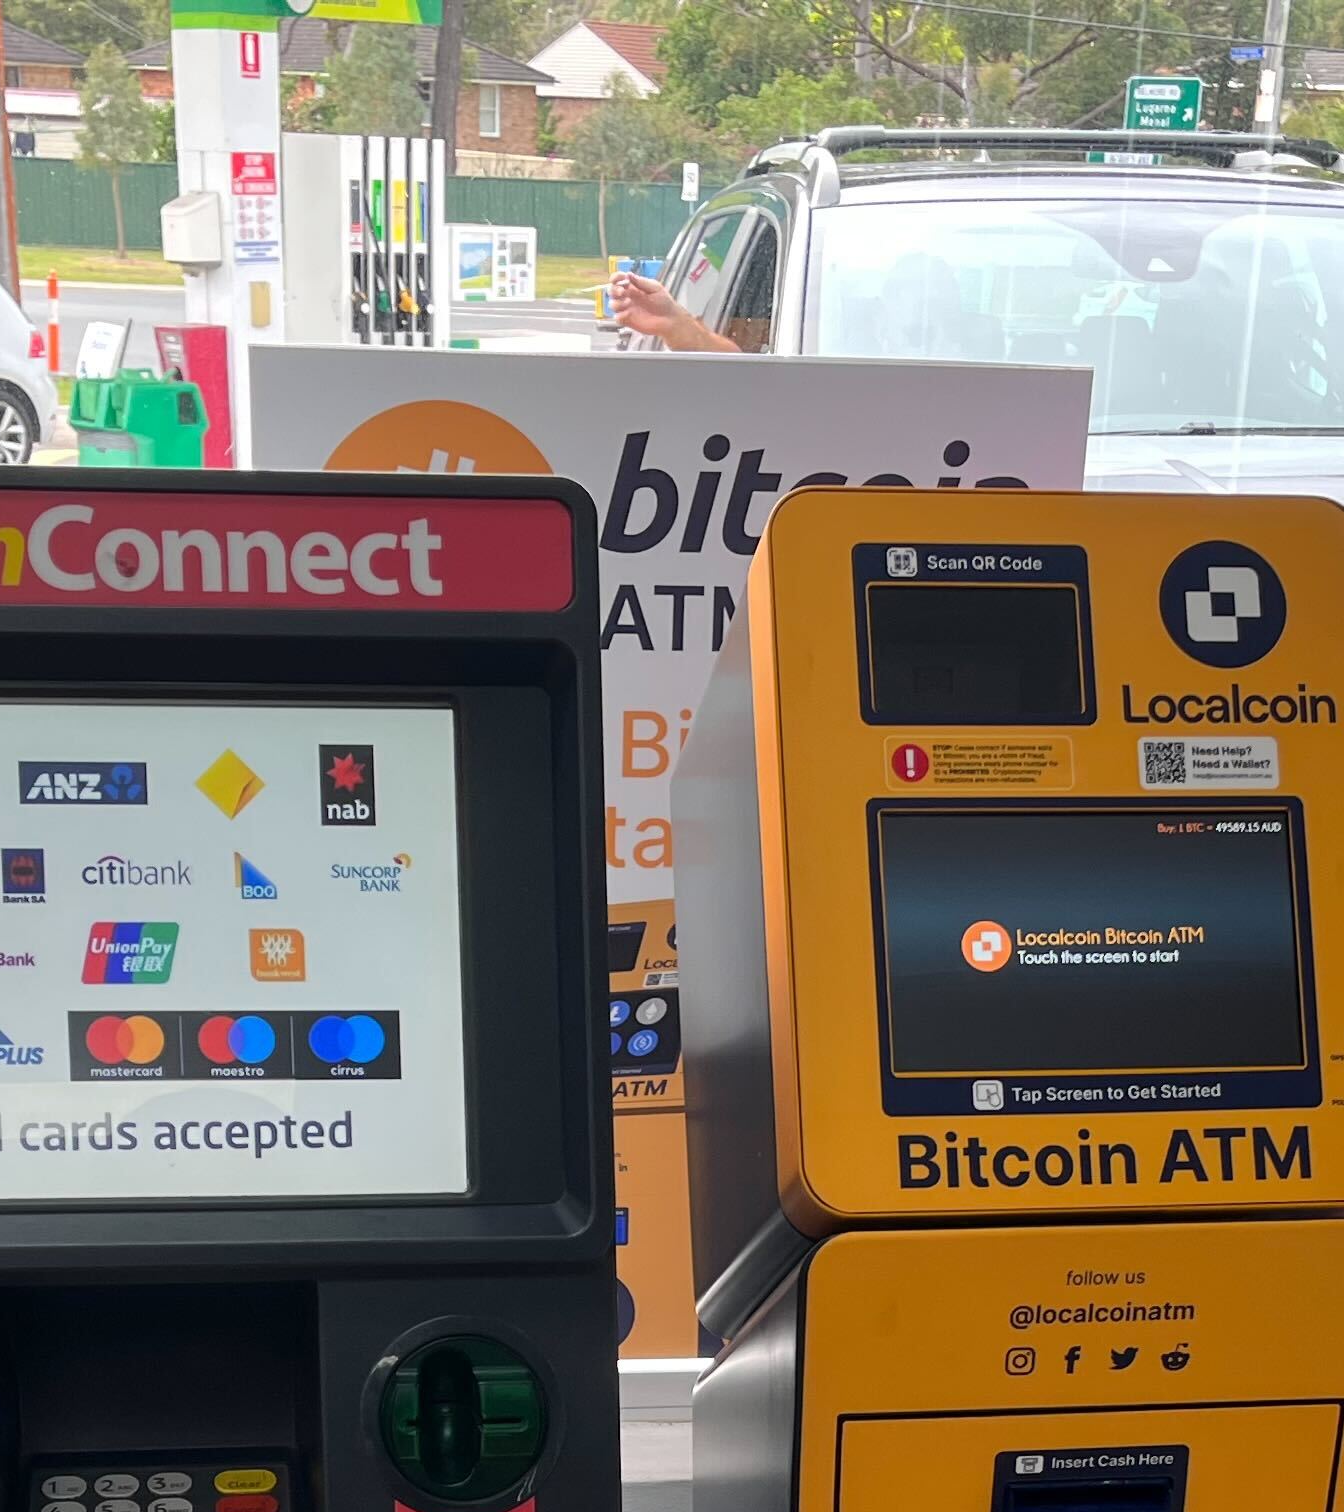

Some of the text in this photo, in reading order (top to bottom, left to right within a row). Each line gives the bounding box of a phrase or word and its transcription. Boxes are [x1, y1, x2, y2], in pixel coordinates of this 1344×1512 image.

[926, 555, 1043, 571] Scan QR Code
[1121, 684, 1337, 725] Localcoin
[1191, 745, 1252, 757] Need Help?
[1192, 759, 1271, 769] Need a Wallet?
[26, 773, 102, 800] ANZ
[326, 799, 370, 820] nab
[1157, 823, 1177, 834] Buy:
[1186, 823, 1205, 833] BTC
[1261, 822, 1282, 833] AUD
[82, 856, 192, 886] citibank
[331, 864, 402, 879] SUNCORP
[243, 886, 276, 898] BOQ
[360, 879, 402, 892] BANK
[1017, 926, 1204, 946] Localcoin Bitcoin ATM
[91, 937, 173, 959] UnionPay
[122, 956, 164, 972] 银联
[1017, 949, 1179, 965] Touch the screen to start
[90, 1065, 163, 1077] mastercard
[210, 1065, 264, 1077] maestro
[330, 1064, 364, 1076] cirrus
[613, 1079, 668, 1098] ATM
[1012, 1083, 1222, 1104] Tap Screen to Get Started
[19, 1112, 137, 1151] cards
[154, 1110, 354, 1159] accepted
[897, 1125, 1313, 1190] Bitcoin ATM
[1066, 1270, 1146, 1286] follow us
[1009, 1301, 1195, 1329] @localcoinatm
[1051, 1453, 1174, 1469] Insert Cash Here
